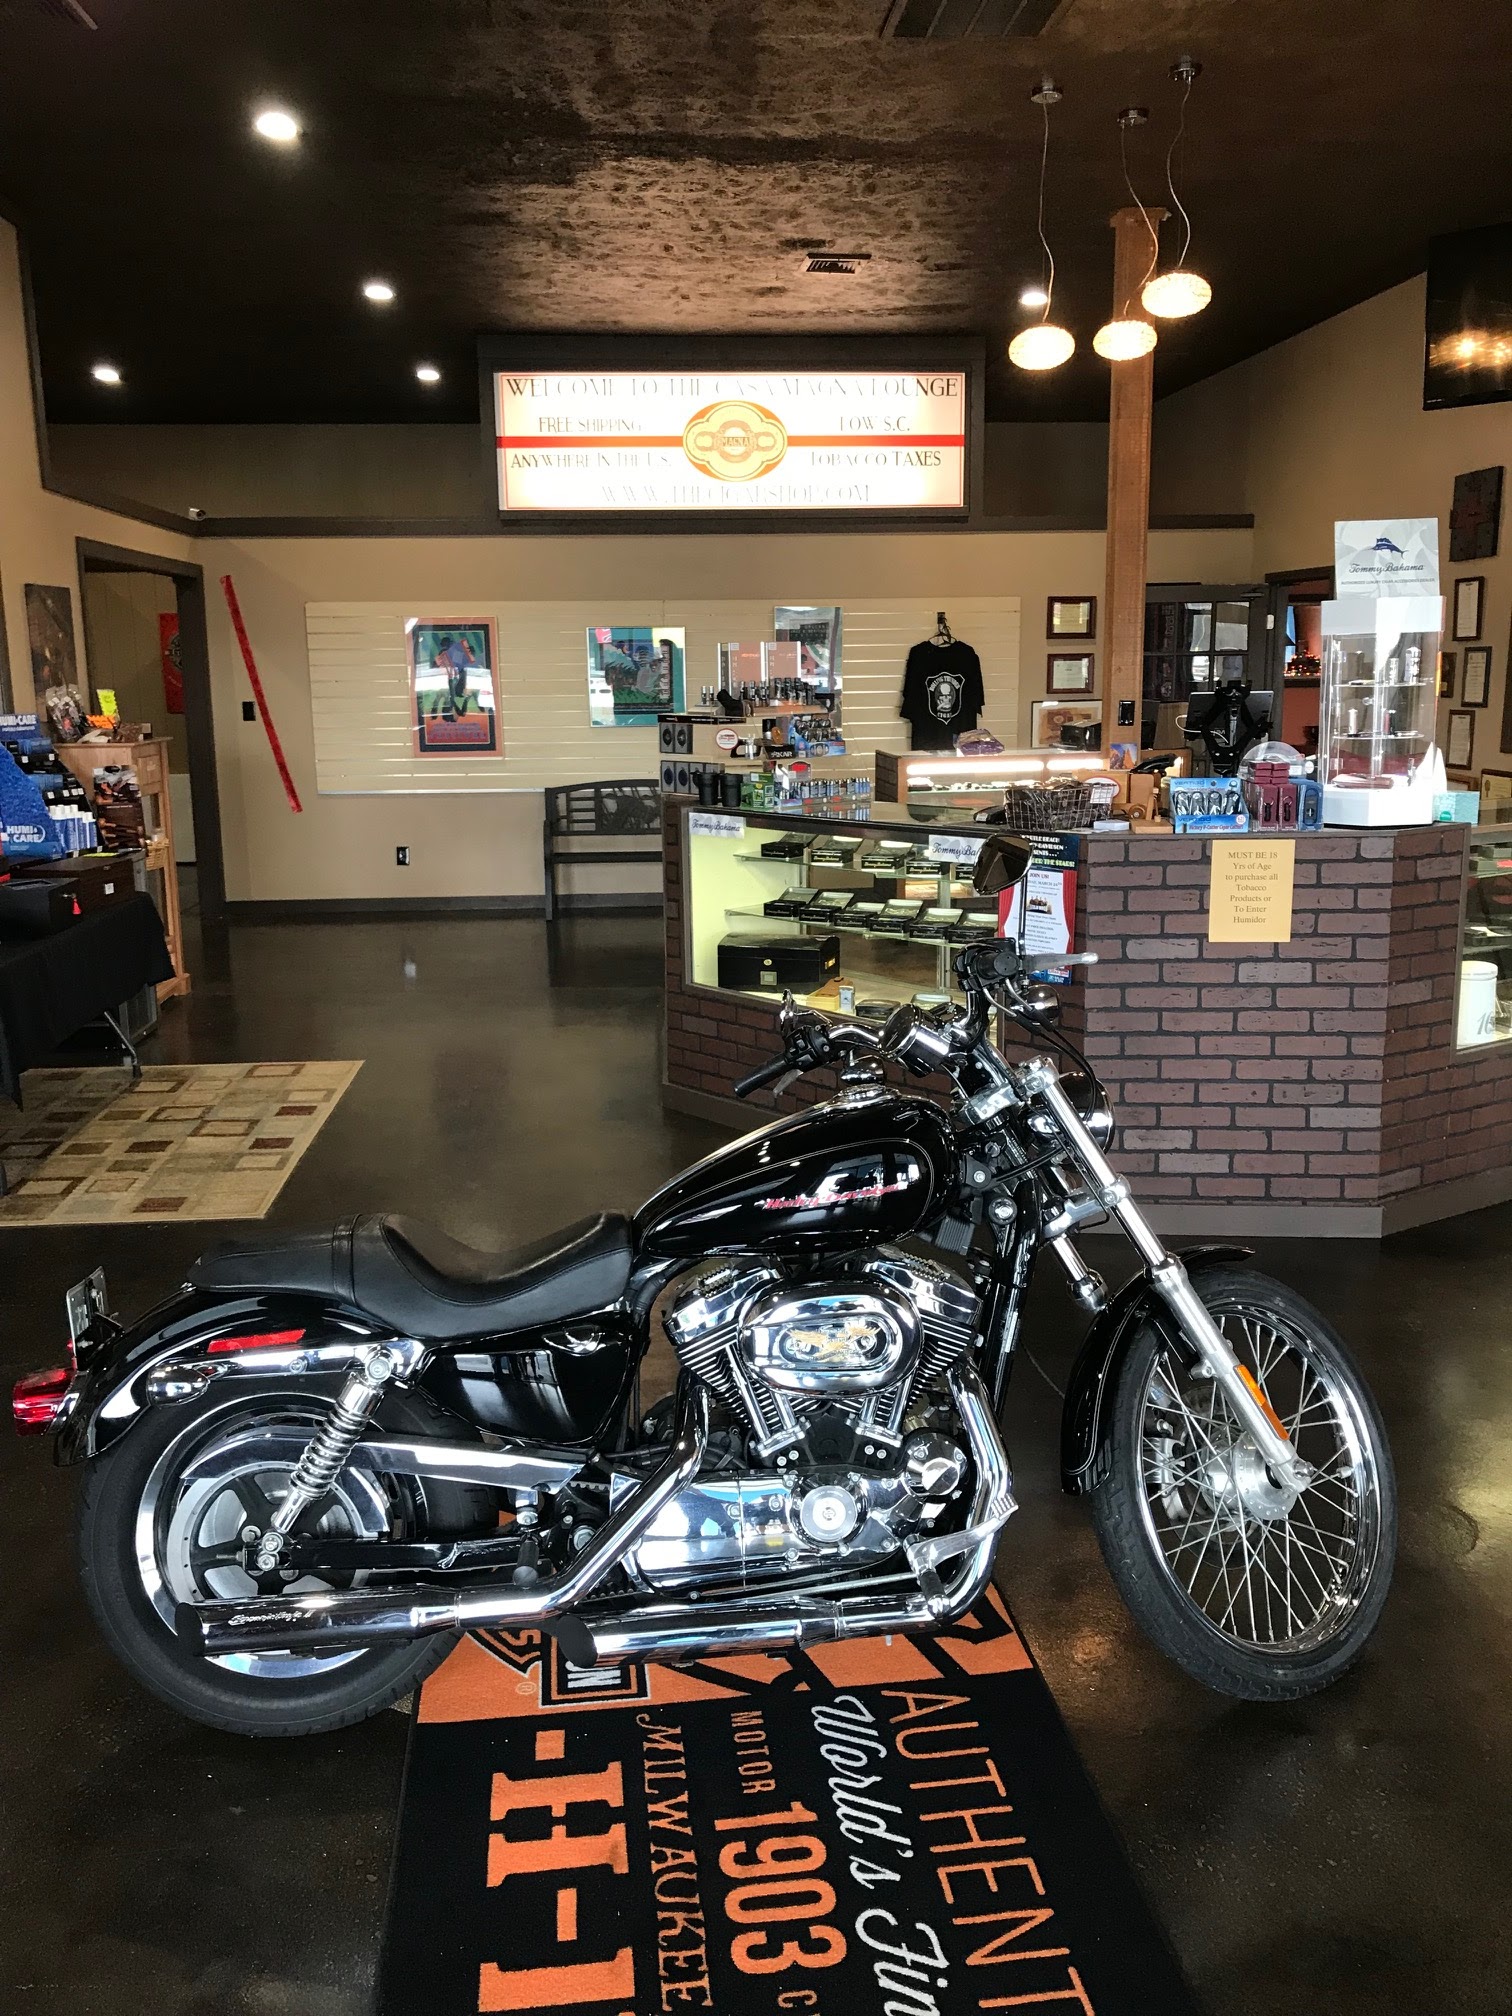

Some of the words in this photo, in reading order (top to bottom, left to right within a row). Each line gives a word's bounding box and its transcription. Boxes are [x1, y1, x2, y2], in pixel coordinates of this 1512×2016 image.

[506, 378, 613, 397] WELCOME
[632, 378, 657, 396] TO
[872, 378, 958, 397] LOUNGE
[538, 416, 574, 433] FREE
[578, 418, 643, 432] SHIPPING
[884, 416, 911, 432] S.C.
[510, 453, 590, 468] ANYWHERE
[811, 451, 887, 467] TOBACCO
[891, 450, 942, 467] TAXES
[1349, 562, 1382, 576] Tommy
[1384, 561, 1424, 573] Bahama
[1257, 863, 1272, 871] Age
[1234, 874, 1267, 883] purchase
[729, 1710, 777, 1795] MOTOR
[810, 1694, 914, 1890] World's
[635, 1712, 714, 2012] MILWAUKEE
[713, 1800, 848, 1975] 1903
